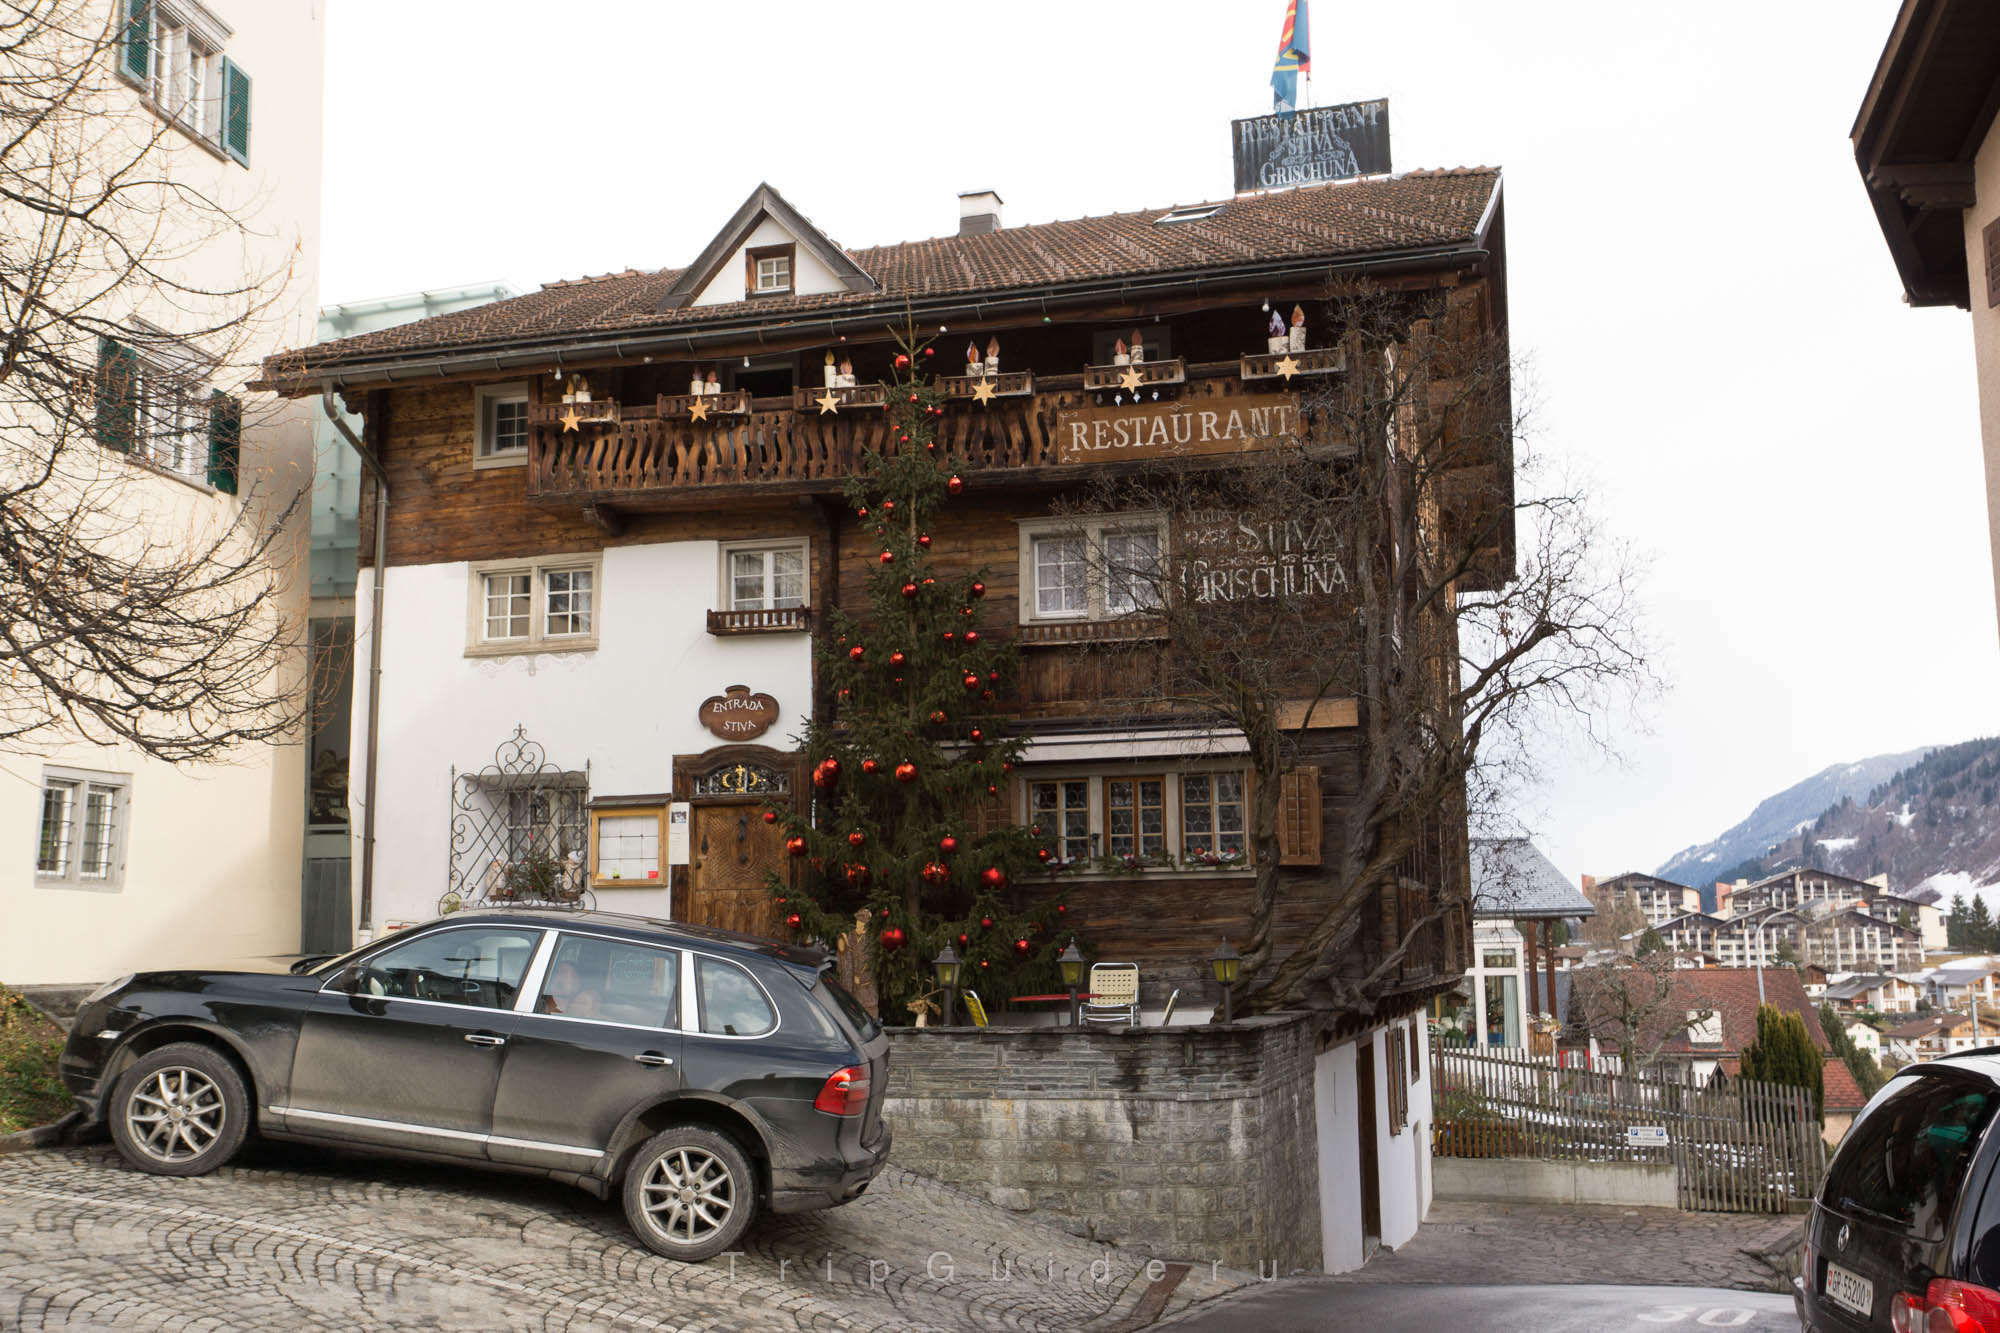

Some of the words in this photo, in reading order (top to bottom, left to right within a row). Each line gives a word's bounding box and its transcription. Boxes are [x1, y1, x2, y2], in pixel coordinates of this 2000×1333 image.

[1240, 102, 1381, 144] RESTAURANT
[1287, 133, 1334, 156] STIVA
[1260, 149, 1361, 186] GRISCHUNA
[1069, 405, 1292, 451] RESTAURANT
[712, 698, 764, 713] ENTRADA
[723, 720, 757, 731] STIVA
